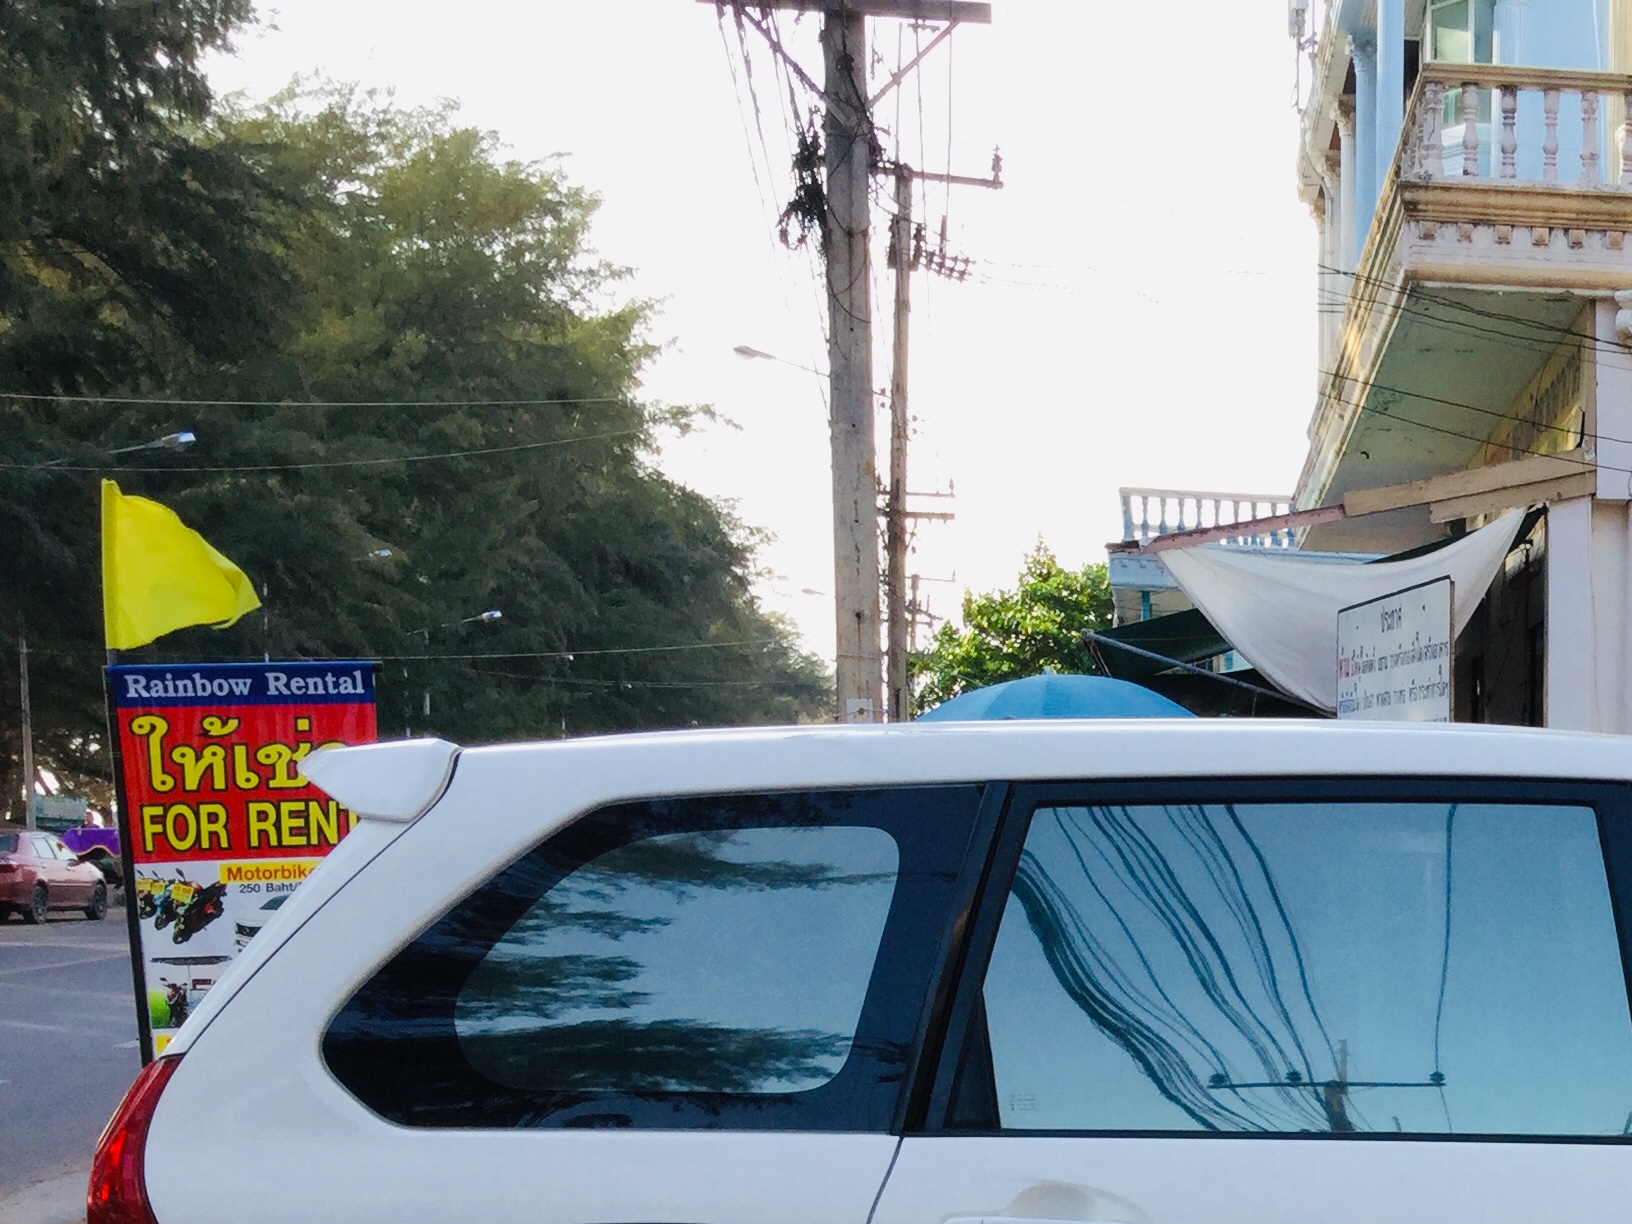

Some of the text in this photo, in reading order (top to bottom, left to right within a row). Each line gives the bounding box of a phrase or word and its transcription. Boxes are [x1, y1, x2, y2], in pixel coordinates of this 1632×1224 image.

[124, 670, 365, 698] Rainbow Rental
[131, 714, 347, 793] ให้เช่
[140, 803, 231, 854] FOR
[239, 883, 261, 894] 250
